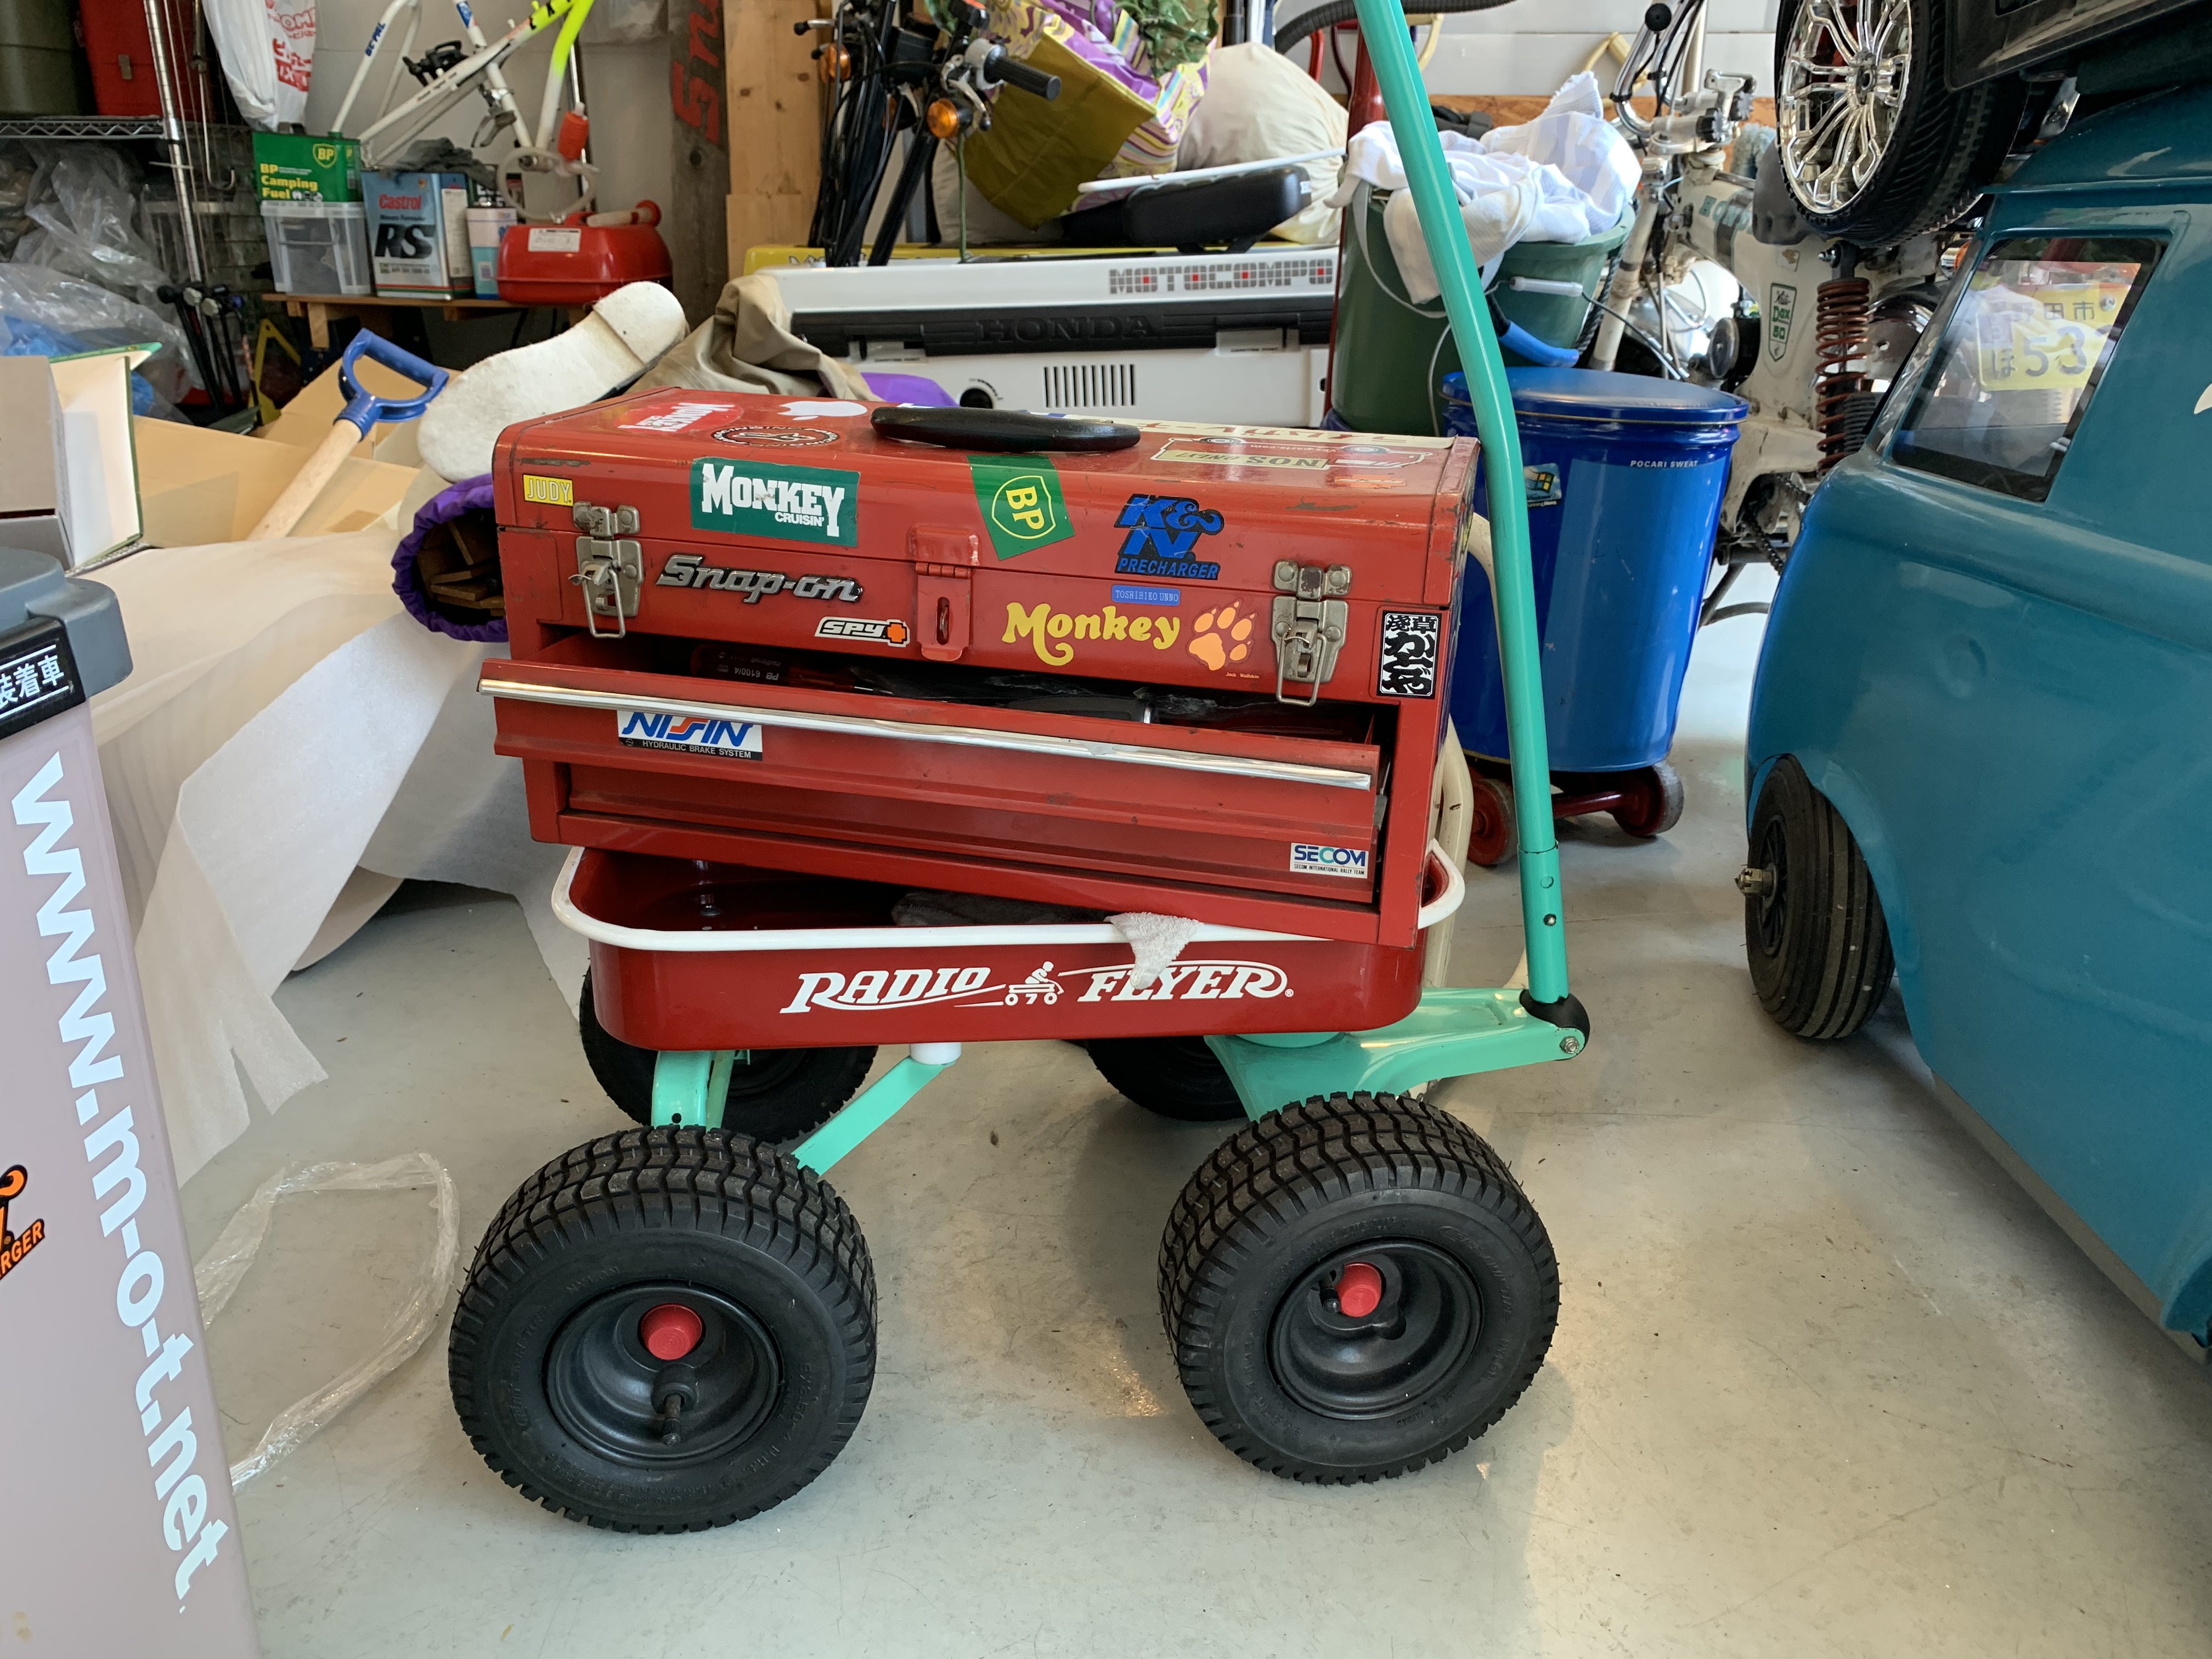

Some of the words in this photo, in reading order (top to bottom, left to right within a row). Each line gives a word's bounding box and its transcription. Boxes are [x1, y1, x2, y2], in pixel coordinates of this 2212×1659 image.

[318, 148, 334, 161] BP
[259, 163, 279, 174] BP
[261, 174, 318, 192] Camping
[262, 187, 291, 200] Fuel
[379, 194, 422, 210] Castrol
[375, 223, 436, 259] RS
[1109, 259, 1333, 294] MOTOCOMPO
[974, 315, 1154, 342] HONDA
[1245, 456, 1323, 467] NOS
[1630, 460, 1667, 469] POCARI
[1669, 460, 1699, 468] SWEAT
[702, 463, 845, 537] MONKEY
[1005, 486, 1045, 531] BP
[775, 511, 825, 527] CRUISIN'
[1118, 558, 1219, 579] PRECHARGER
[656, 554, 863, 604] Snap-on
[1115, 589, 1157, 601] TOSHIHIKO
[1159, 591, 1178, 602] UNNO
[1001, 602, 1180, 666] Monkey
[642, 740, 686, 752] HYDRAULIC
[689, 745, 716, 755] BRAKE
[719, 748, 752, 759] SYSTEM
[1294, 845, 1366, 867] SECOM
[1309, 865, 1339, 873] INTERNATIONAL
[779, 967, 991, 1014] RADIO
[1077, 960, 1288, 1002] FLYER
